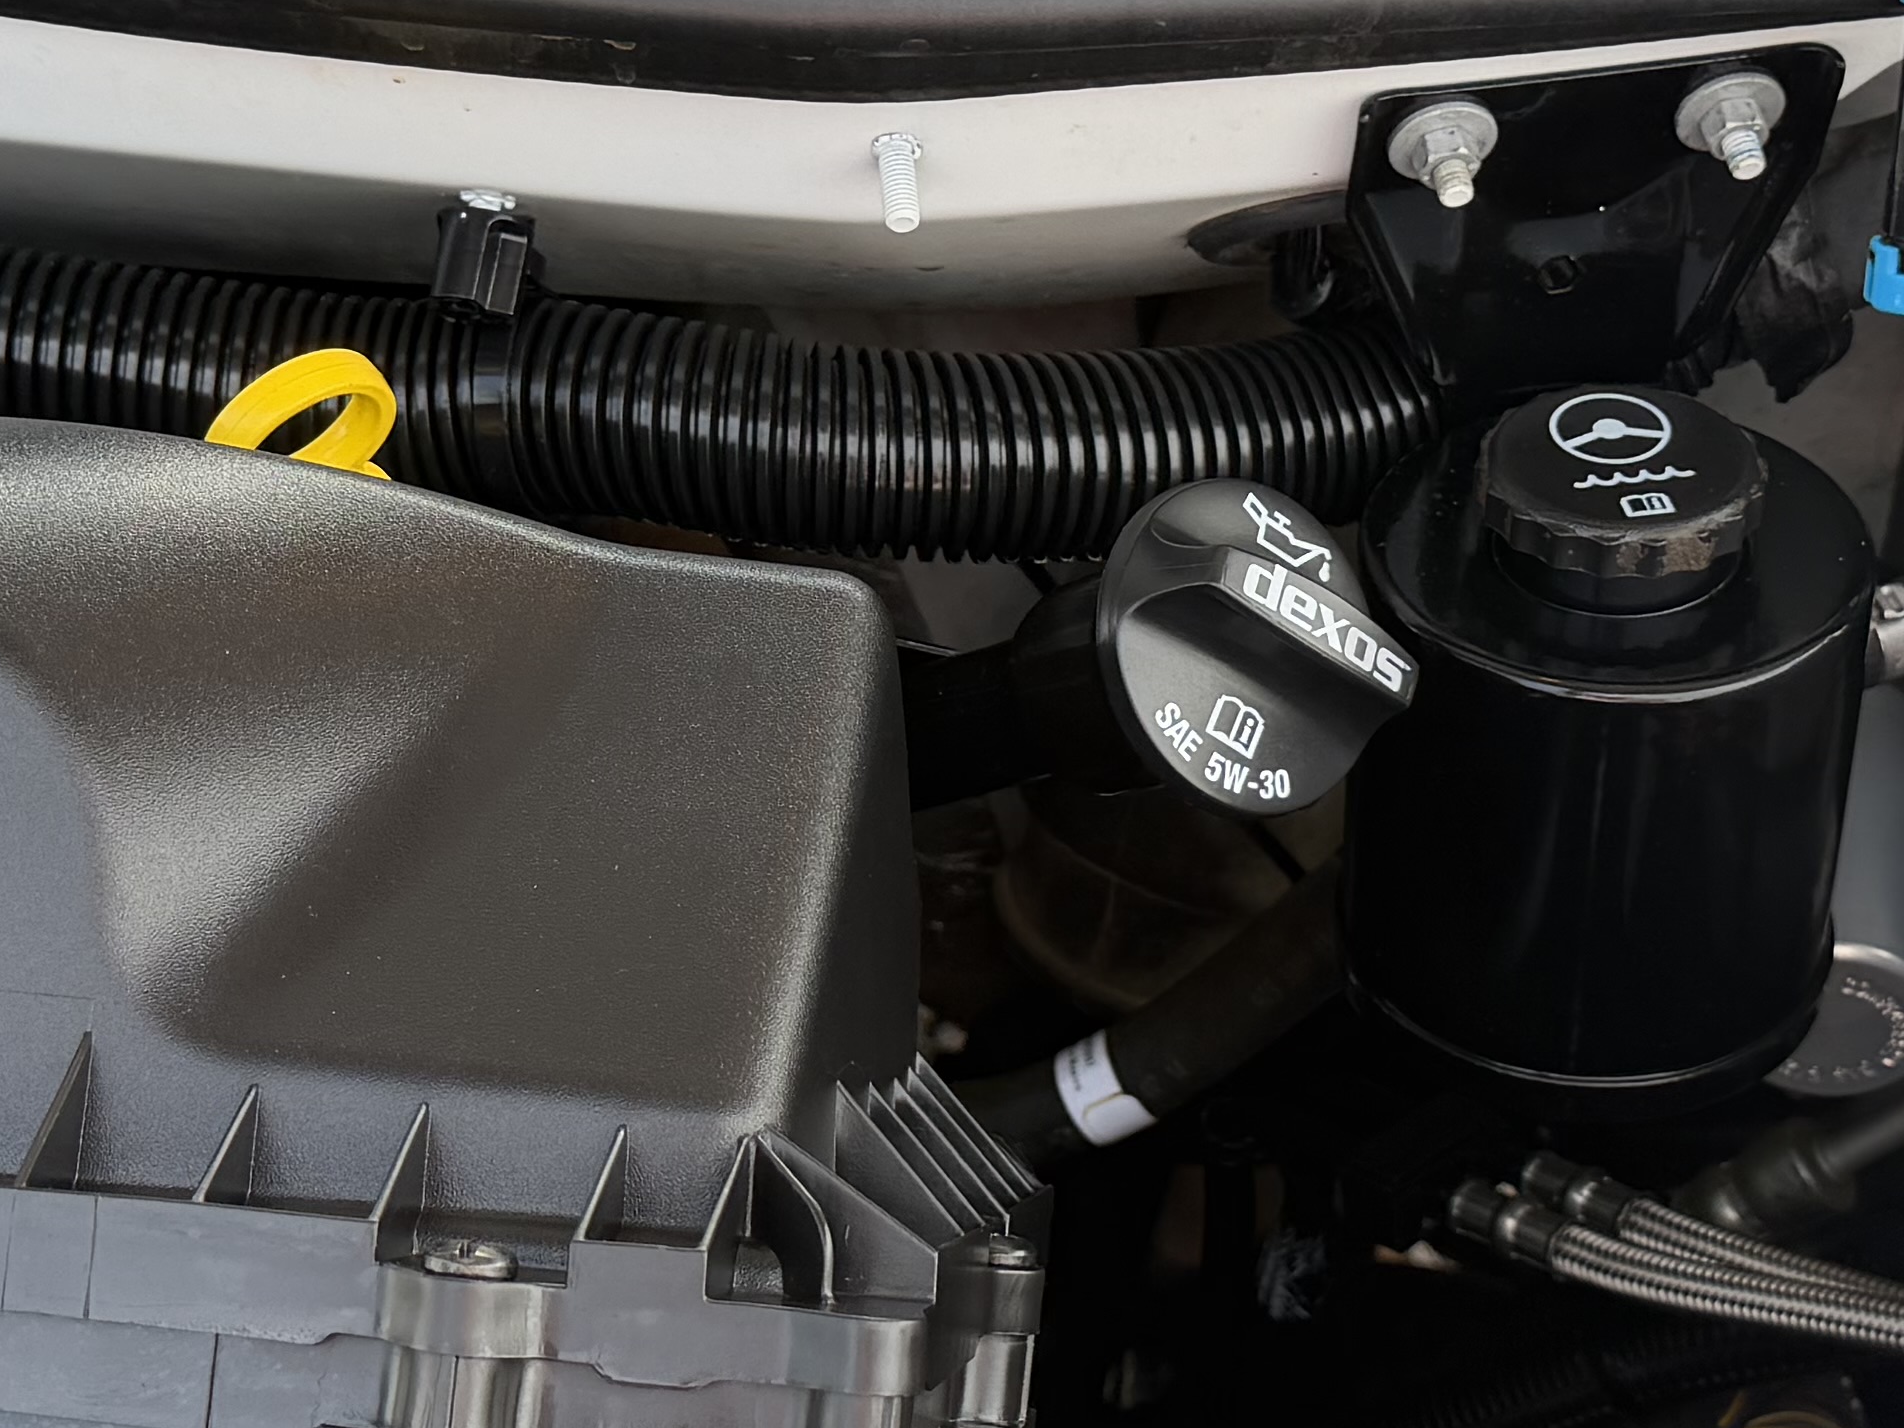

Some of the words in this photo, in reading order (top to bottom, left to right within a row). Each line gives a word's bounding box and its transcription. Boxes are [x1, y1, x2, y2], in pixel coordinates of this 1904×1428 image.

[1242, 563, 1412, 692] dexos
[1154, 702, 1204, 762] SAE
[1204, 751, 1291, 800] 5W-30
